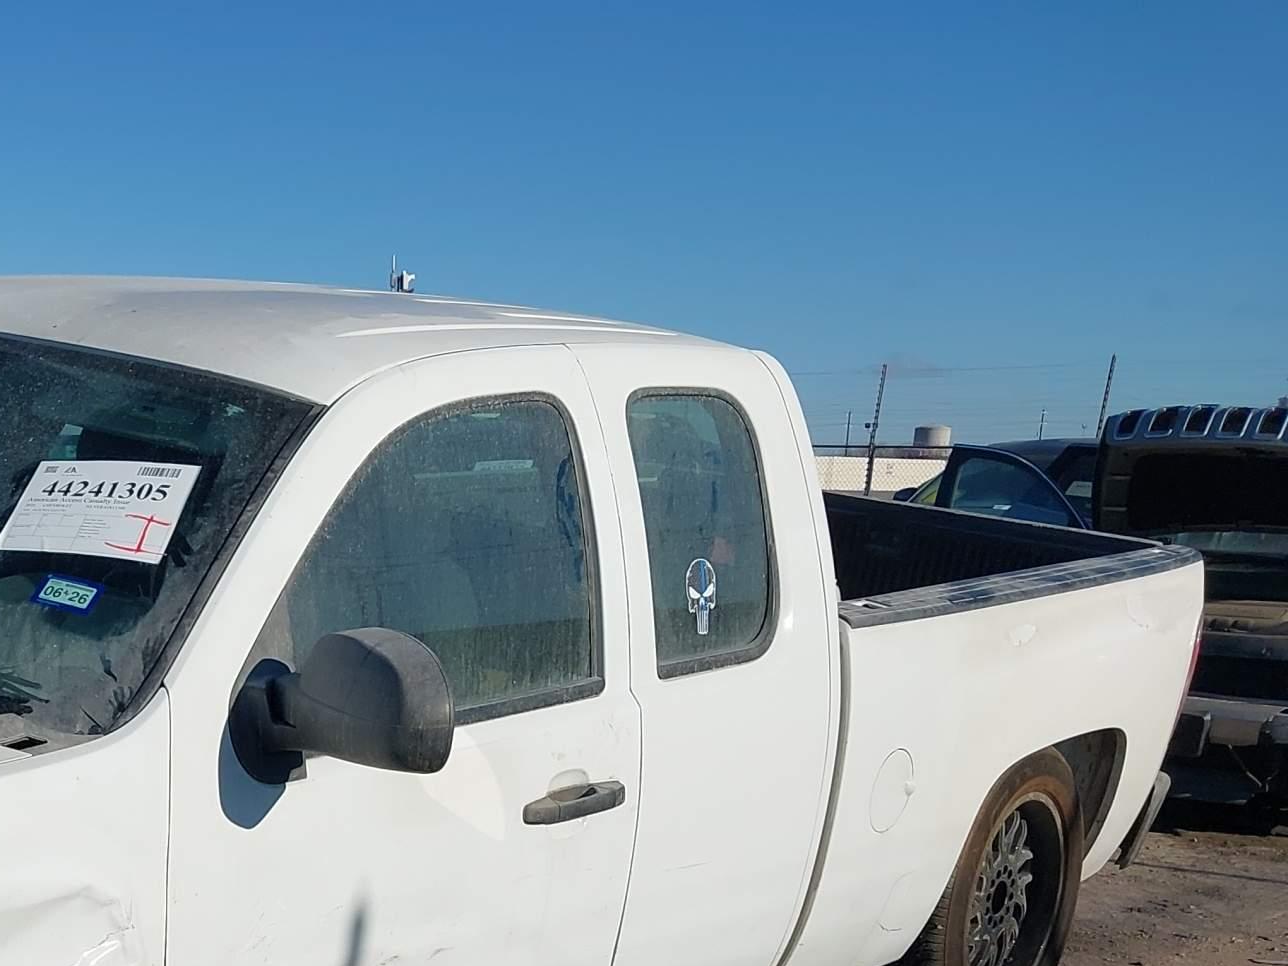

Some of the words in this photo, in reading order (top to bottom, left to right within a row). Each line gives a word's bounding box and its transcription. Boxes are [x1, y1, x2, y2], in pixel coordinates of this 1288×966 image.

[42, 480, 171, 501] 44241305
[43, 585, 64, 598] 06
[67, 591, 89, 604] 26
